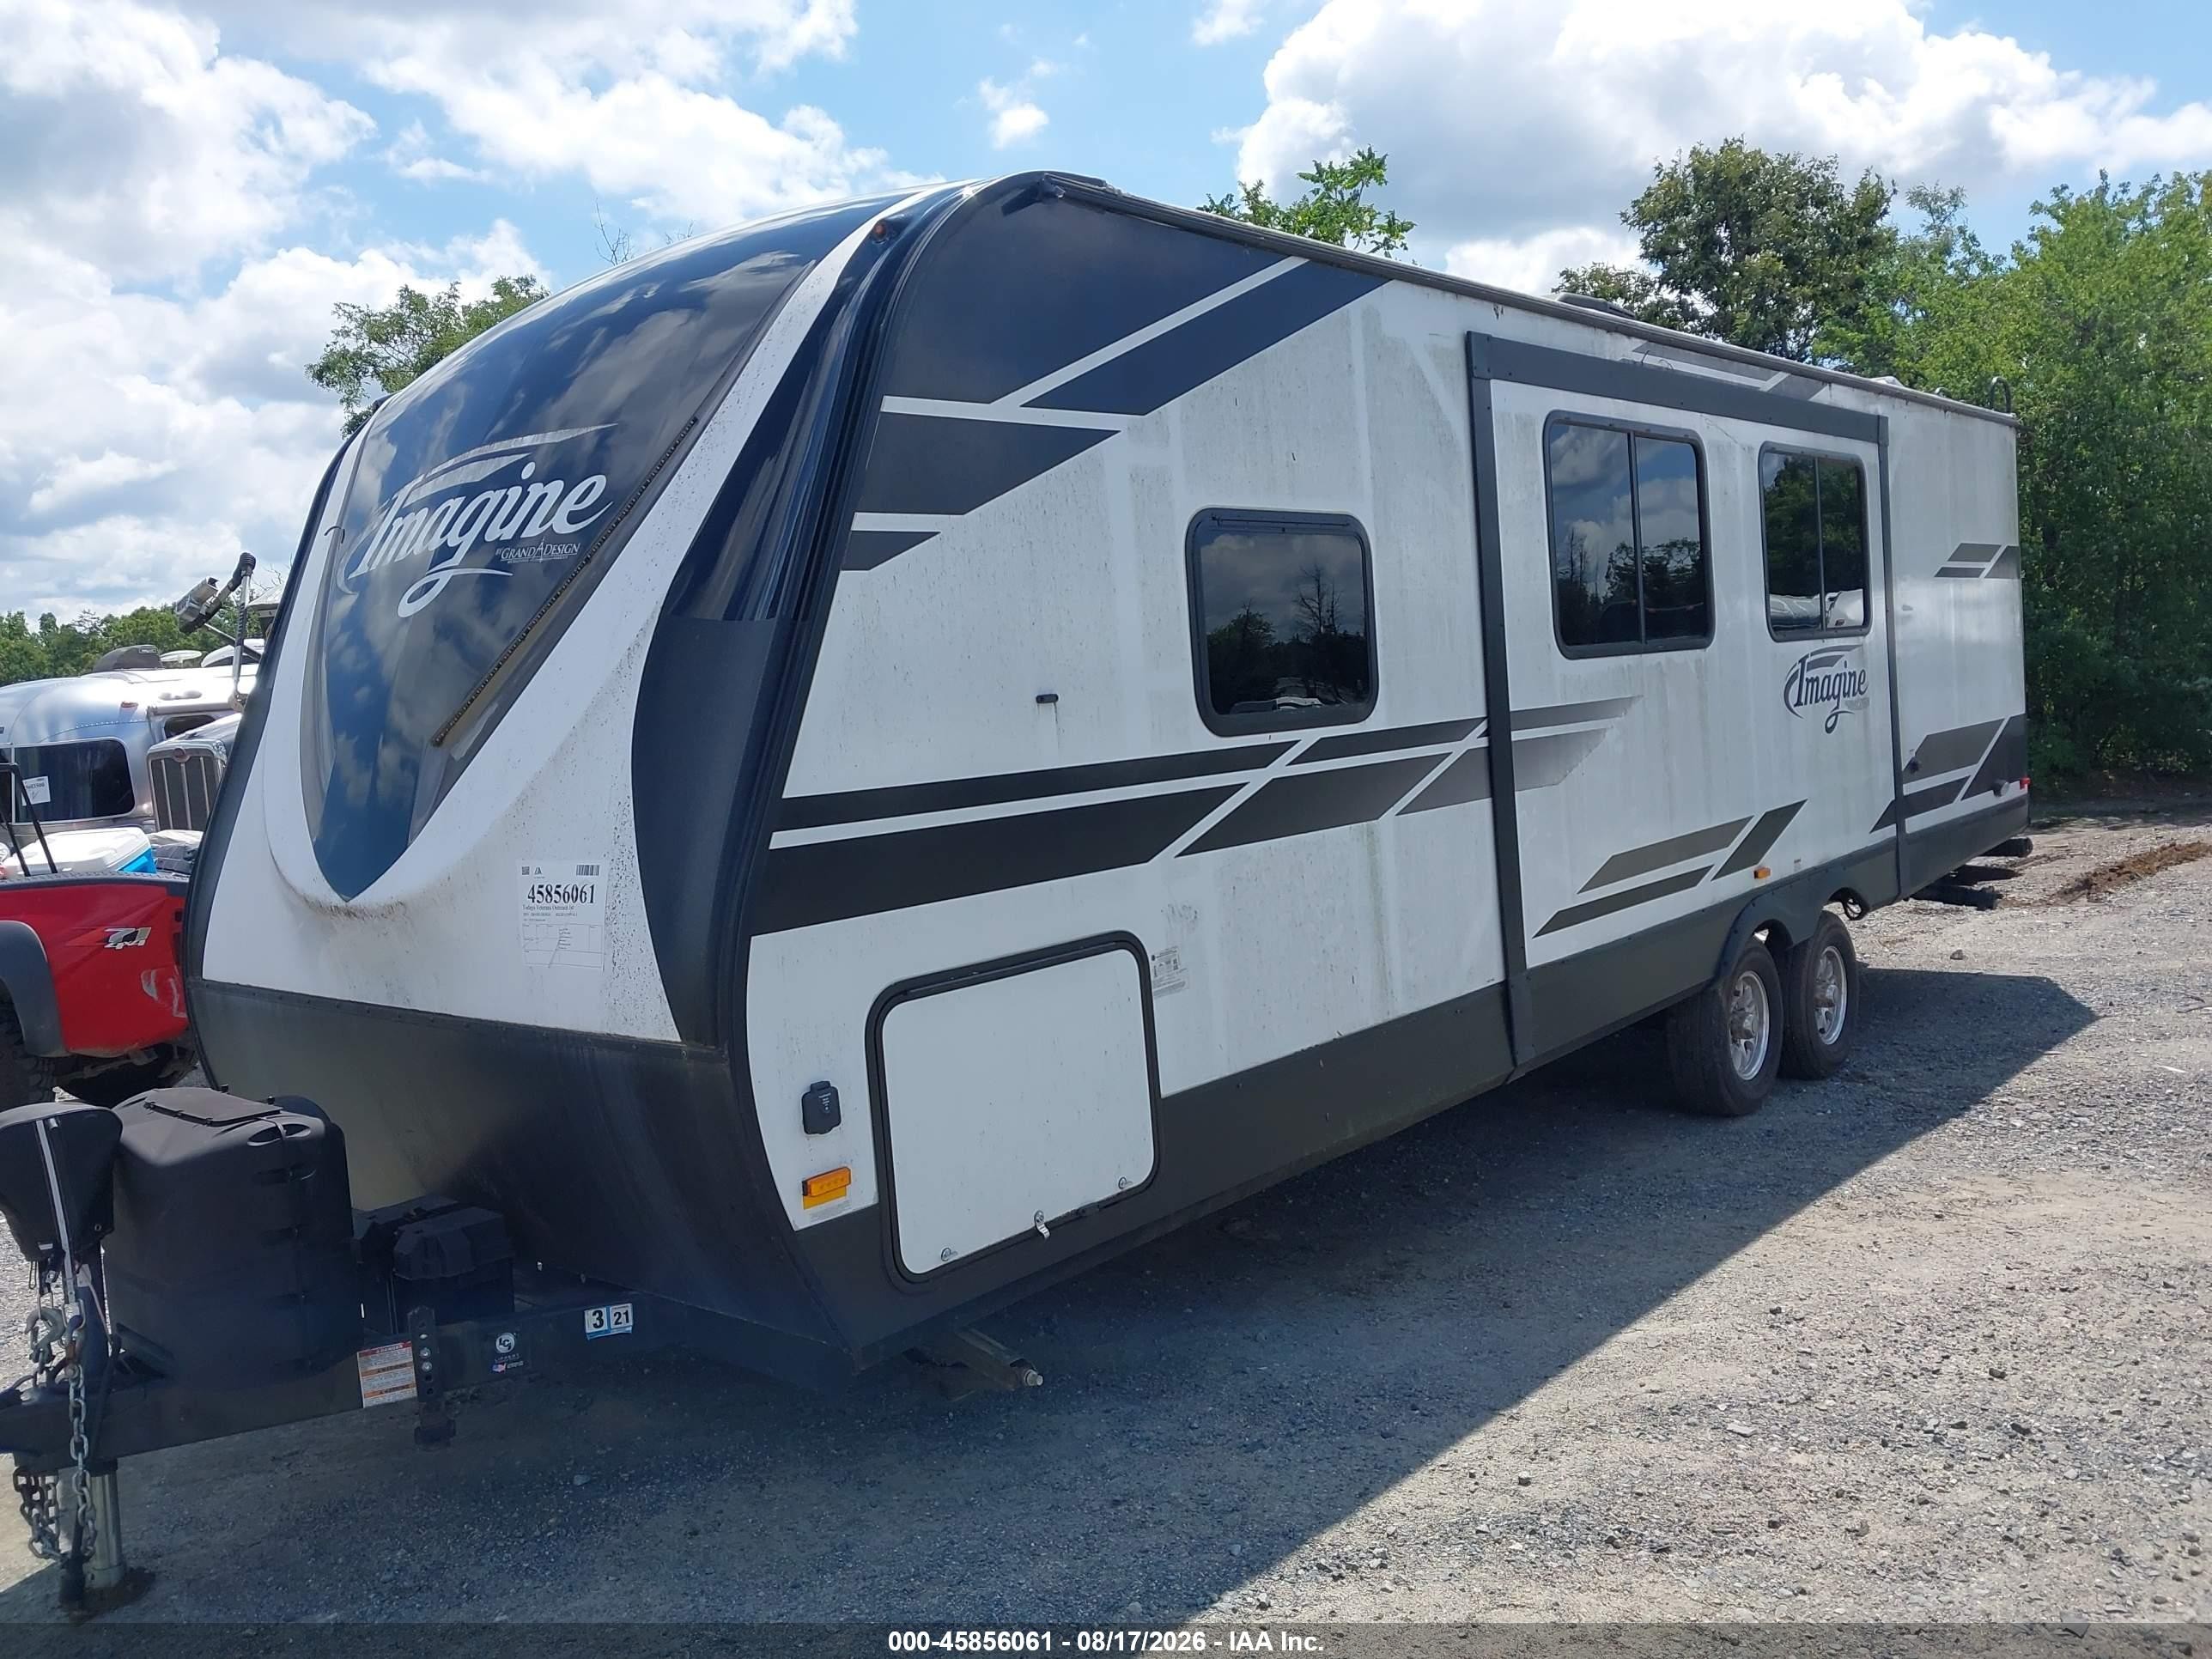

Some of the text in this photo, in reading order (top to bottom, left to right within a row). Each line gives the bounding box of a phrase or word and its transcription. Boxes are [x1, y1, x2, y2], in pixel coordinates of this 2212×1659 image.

[347, 461, 613, 617] Imagine
[501, 546, 536, 559] GRAND
[544, 543, 580, 556] DESIGN
[1793, 654, 1869, 734] Imagine
[527, 884, 595, 904] 45856061
[592, 1310, 629, 1329] 3 21
